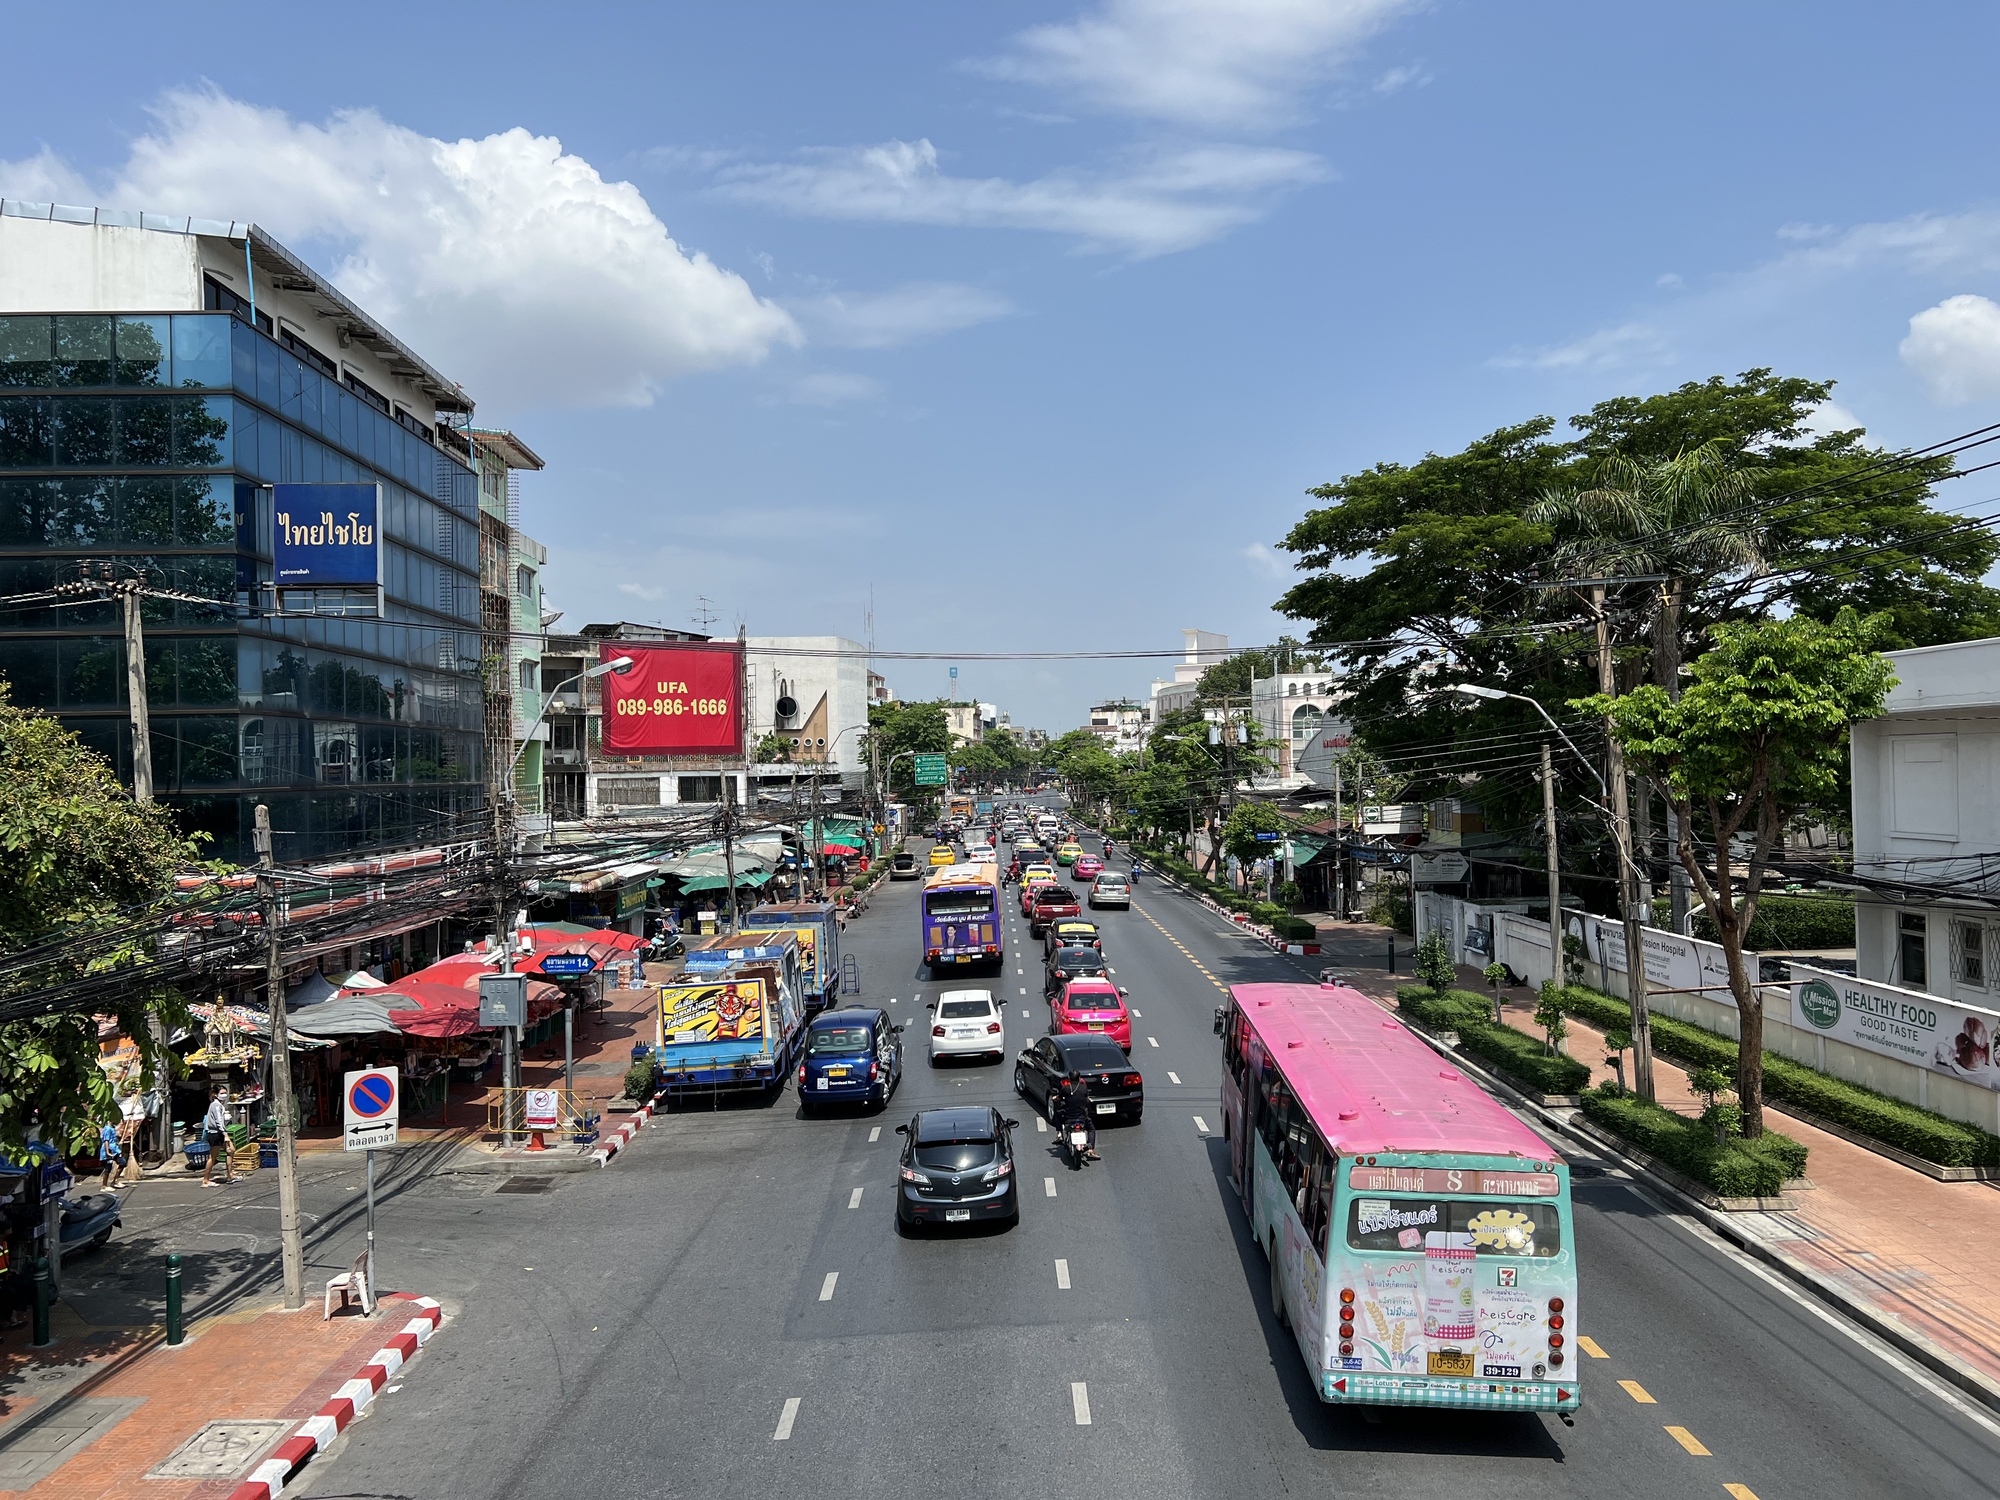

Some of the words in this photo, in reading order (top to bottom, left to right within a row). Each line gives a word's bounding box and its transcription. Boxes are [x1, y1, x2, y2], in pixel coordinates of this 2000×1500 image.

[276, 511, 373, 546] ไทยไชโย
[657, 682, 688, 693] UFA
[617, 698, 727, 715] 089-986-1666
[1661, 941, 1687, 957] Hospital
[577, 957, 589, 968] 14
[1809, 991, 1837, 1008] Mission
[1822, 1006, 1837, 1018] Mart
[1844, 989, 1898, 1018] HEALTHY
[1901, 1003, 1937, 1028] FOOD
[1860, 1015, 1886, 1032] GOOD
[1889, 1023, 1919, 1042] TASTE
[348, 1133, 394, 1147] ตลอดเวลา
[1480, 1308, 1536, 1321] ReisCare
[1485, 1350, 1515, 1364] ไม่อุดตัน
[1485, 1366, 1519, 1376] 39-129
